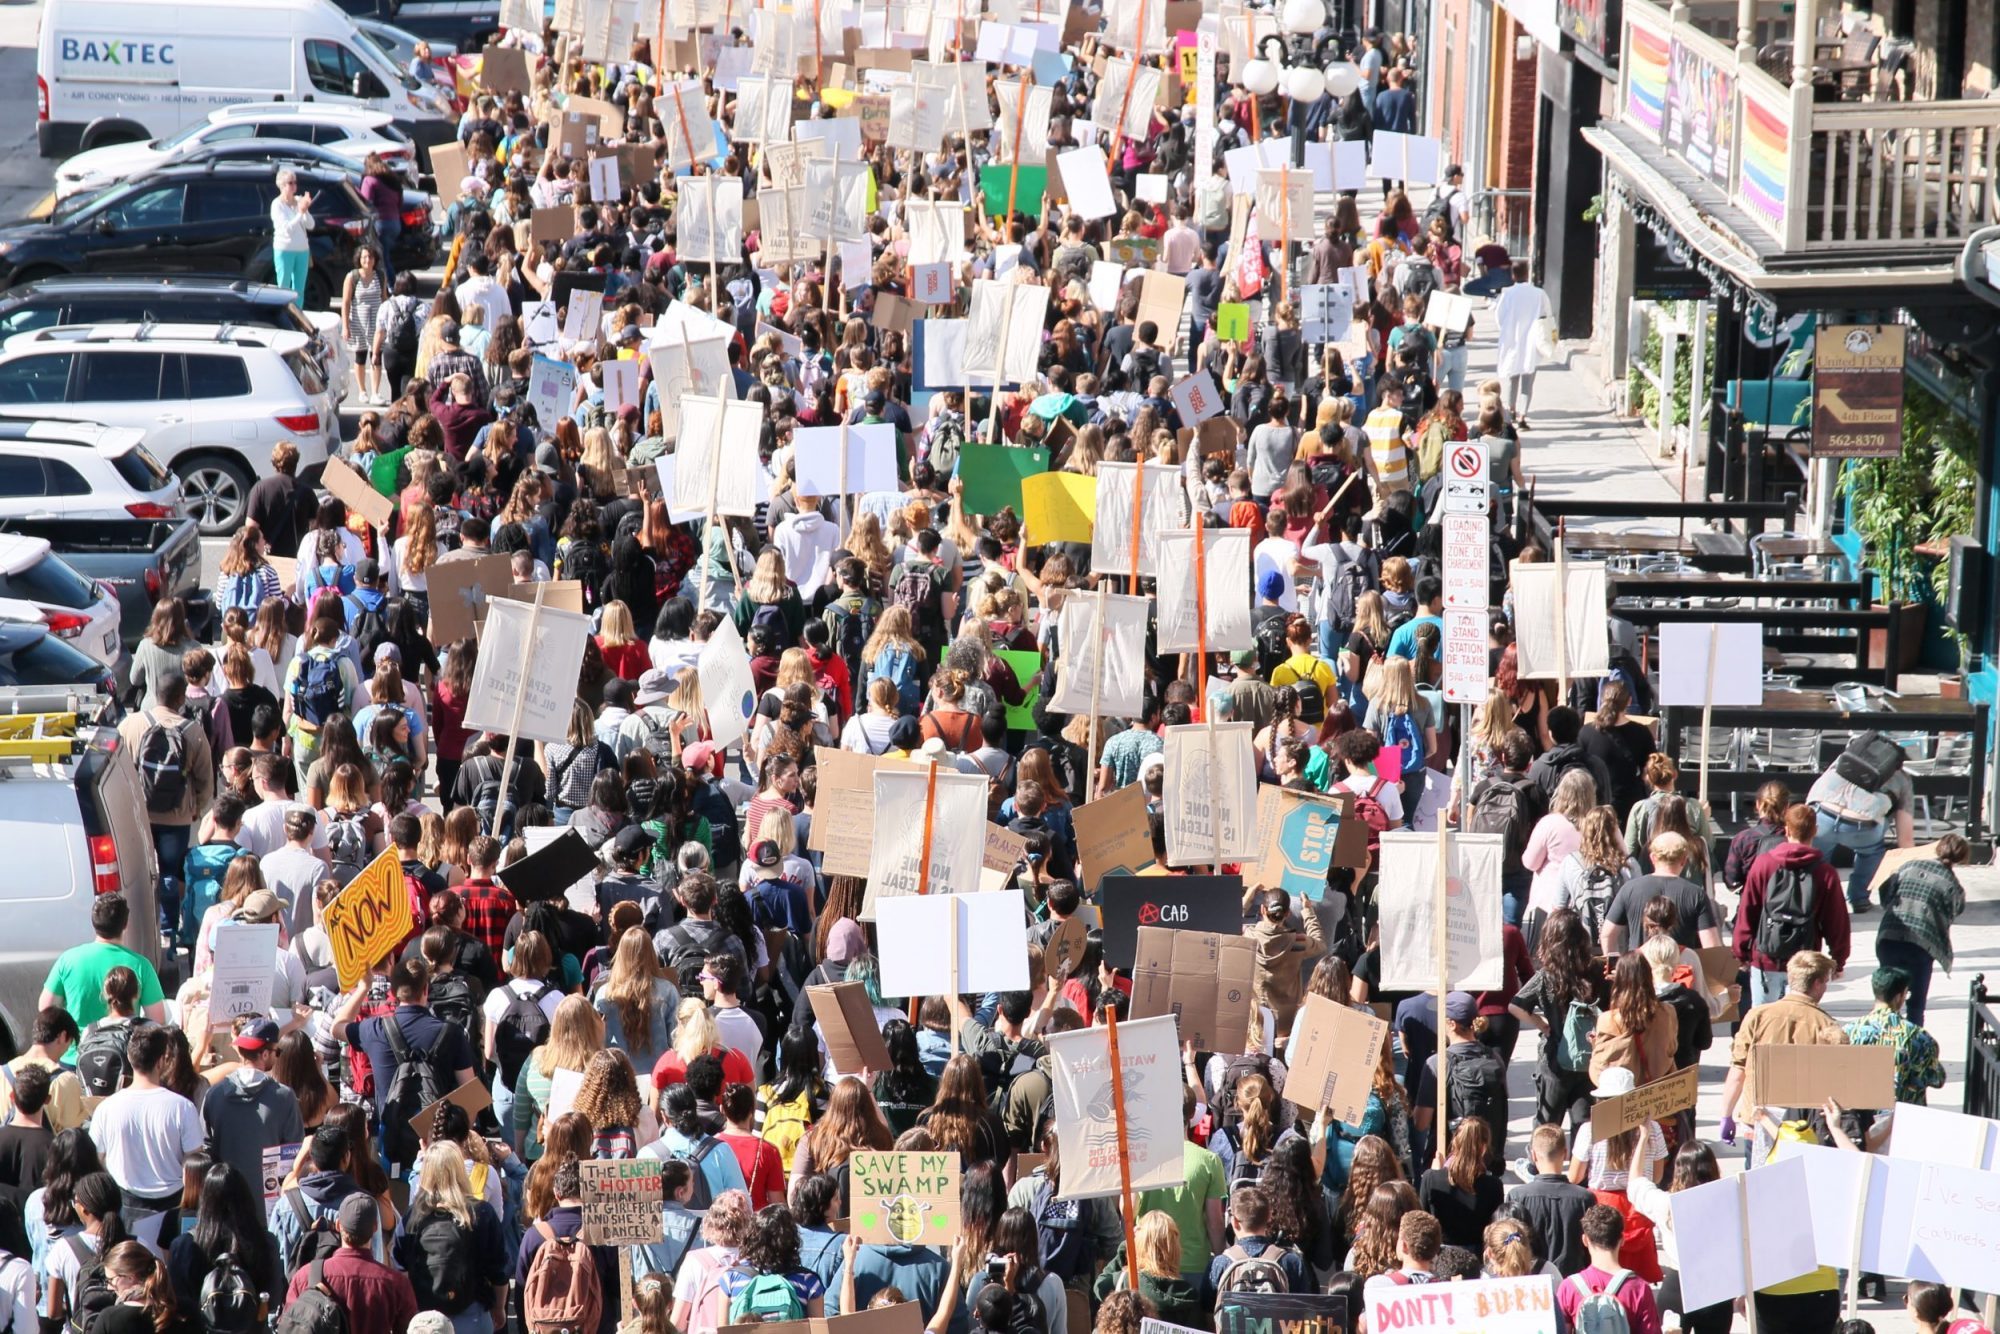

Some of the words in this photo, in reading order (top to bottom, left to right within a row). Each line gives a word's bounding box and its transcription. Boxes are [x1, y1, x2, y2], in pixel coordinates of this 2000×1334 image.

[62, 38, 174, 65] BAXTEC
[88, 92, 149, 101] CONDITIONING
[161, 95, 197, 103] HEATING
[1818, 355, 1856, 367] United
[1860, 356, 1899, 367] TESOL
[1843, 412, 1857, 421] 4th
[1863, 412, 1893, 421] Floor
[1828, 434, 1885, 446] 562-8370
[1448, 519, 1483, 531] LOADING
[1455, 532, 1477, 543] ZONE
[1447, 546, 1470, 557] ZONE
[1473, 547, 1484, 558] DE
[1447, 558, 1484, 570] CHARGEMENT
[1457, 615, 1475, 626] TAXI
[1452, 627, 1479, 638] STAND
[1448, 642, 1483, 653] STATION
[1446, 654, 1457, 664] DE
[1462, 655, 1485, 666] TAXIS
[1300, 812, 1327, 864] STOP
[1323, 826, 1337, 855] ALTO
[329, 897, 345, 929] ACT
[341, 869, 391, 961] NOW
[1626, 1092, 1637, 1102] WE
[1638, 1087, 1655, 1098] ARE
[1623, 1109, 1650, 1123] TEACH
[1654, 1099, 1674, 1116] YOU
[584, 1165, 616, 1178] THE
[619, 1161, 661, 1179] EARTH
[854, 1154, 908, 1176] SAVE
[921, 1155, 948, 1173] MY
[583, 1180, 597, 1192] IS
[600, 1176, 662, 1192] HOTTER
[863, 1176, 949, 1196] SWAMP
[594, 1192, 637, 1203] THAN
[583, 1203, 599, 1213] MY
[604, 1201, 663, 1214] GIRLFRIEND
[611, 1214, 645, 1225] SHE'S
[651, 1214, 660, 1226] A
[602, 1225, 657, 1240] DANCER)
[1376, 1292, 1455, 1334] DONT!
[1475, 1284, 1551, 1318] BURN
